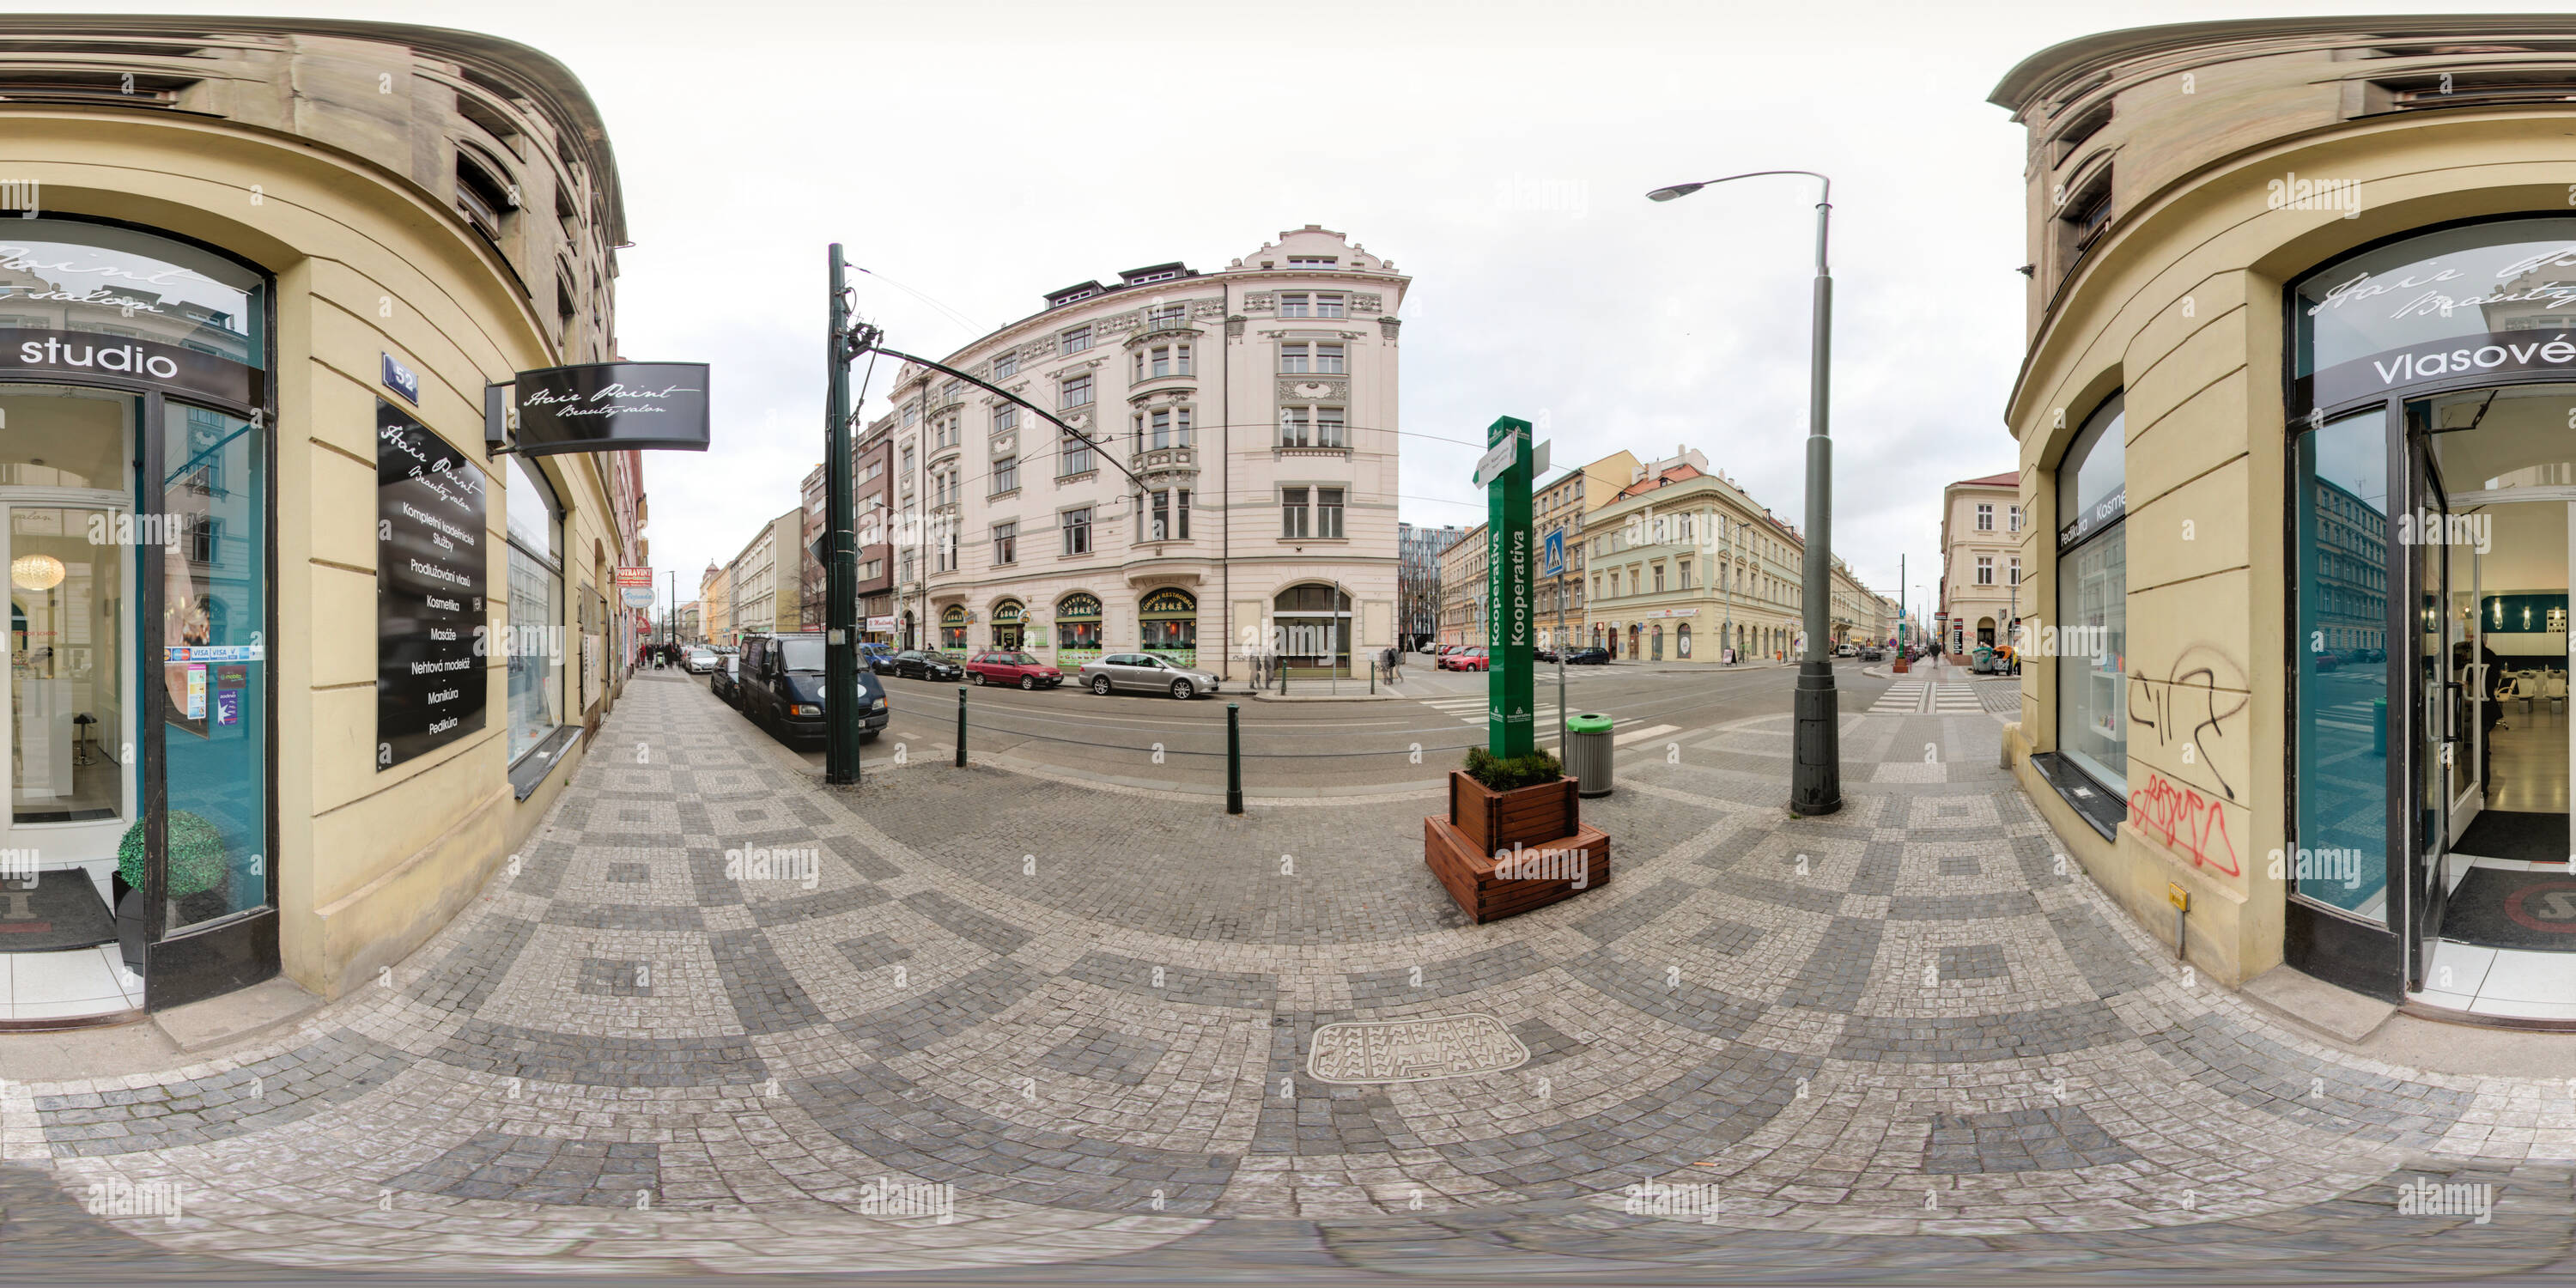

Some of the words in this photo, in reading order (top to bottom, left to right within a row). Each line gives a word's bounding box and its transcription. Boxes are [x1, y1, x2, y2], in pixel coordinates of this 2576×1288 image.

[2307, 262, 2466, 317] Hair
[20, 337, 179, 380] studio
[2373, 333, 2576, 386] Vlasové
[395, 367, 414, 392] 52
[524, 386, 582, 407] Hair
[590, 382, 701, 403] Point
[556, 404, 624, 418] Beauty
[623, 404, 667, 413] salon
[381, 425, 427, 463] Hair
[432, 457, 483, 495] Point
[409, 465, 452, 501] Beauty
[450, 495, 471, 512] salon
[403, 501, 441, 531] Kompletní
[433, 532, 454, 553] Služby
[2061, 519, 2087, 547] Pedikúra
[410, 558, 455, 583] Prodlužování
[455, 573, 471, 587] vlasů
[1491, 531, 1501, 647] Kooperativa
[1510, 530, 1528, 646] Kooperativa
[427, 595, 459, 612] Kosmetika
[431, 628, 456, 641] Masáže
[411, 661, 442, 675] Nehtová
[444, 657, 471, 672] modeláž
[428, 689, 459, 705] Manikúra
[429, 716, 458, 736] Pedikúra
